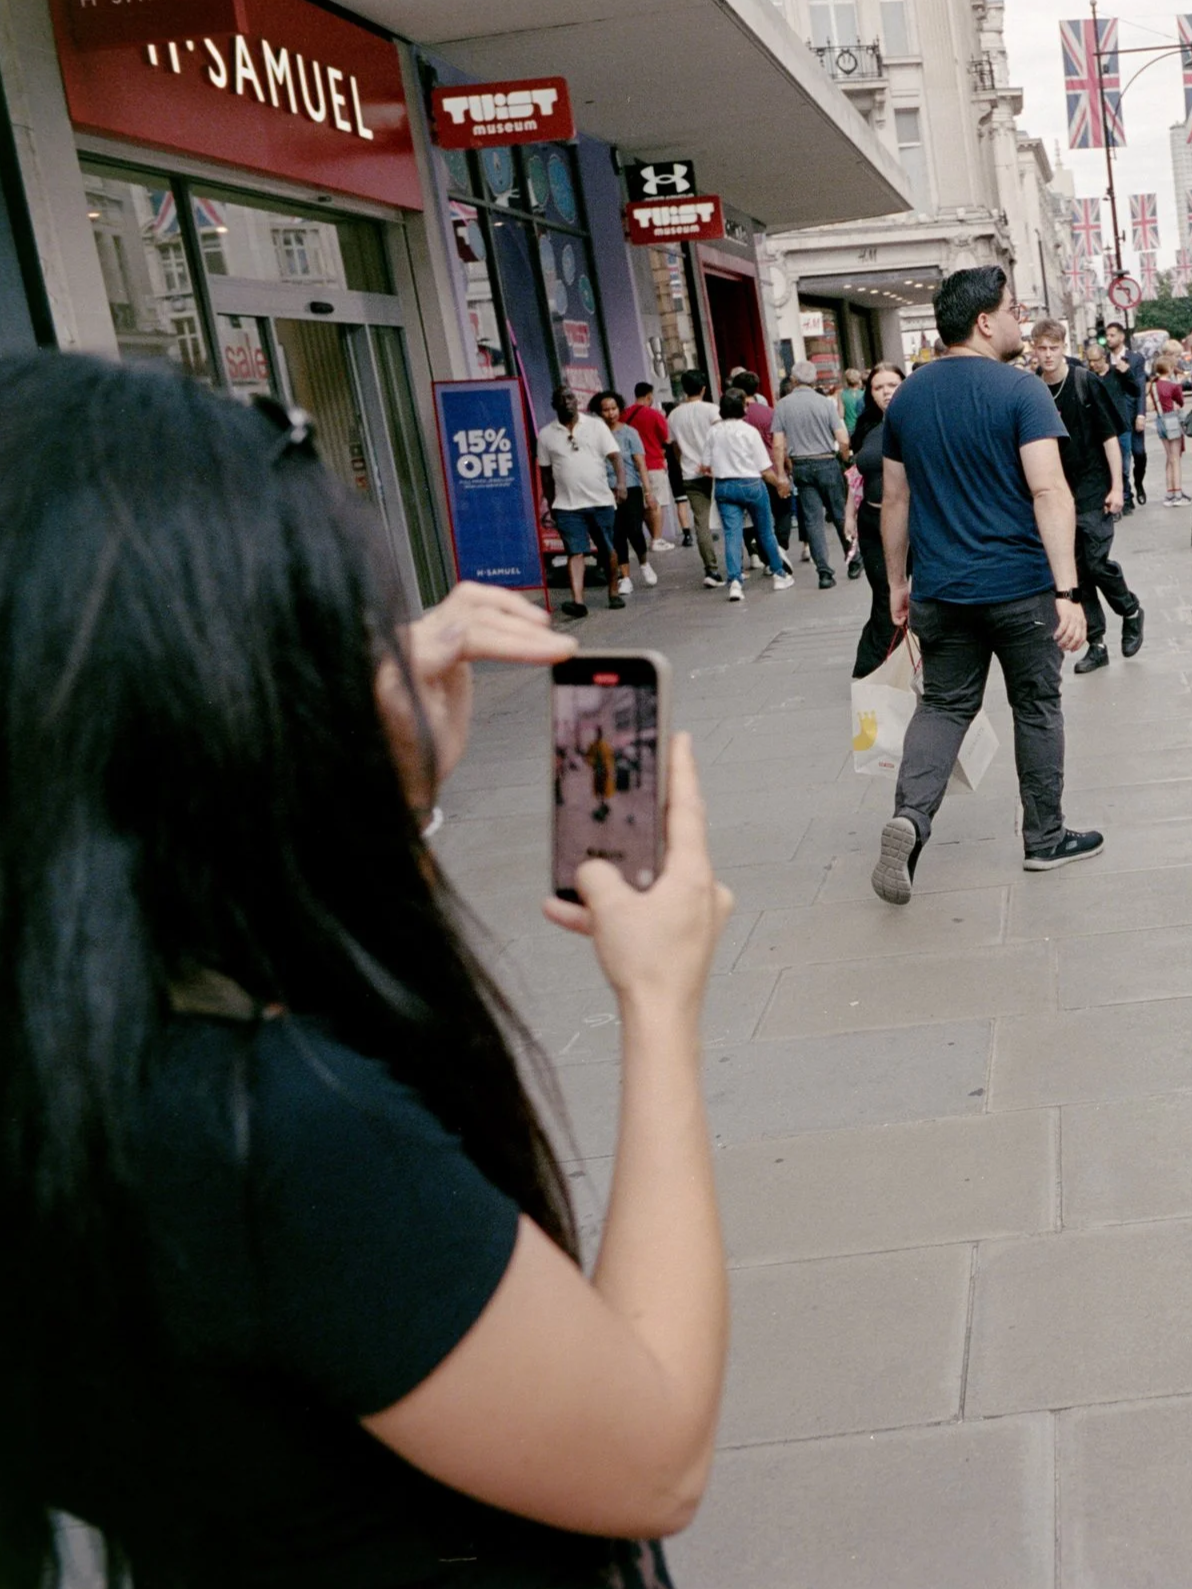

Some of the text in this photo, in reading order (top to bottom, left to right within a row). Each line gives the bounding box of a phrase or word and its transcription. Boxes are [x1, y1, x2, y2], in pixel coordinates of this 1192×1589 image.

[472, 120, 538, 136] museum
[653, 224, 700, 236] museum
[453, 428, 512, 454] 15%
[457, 453, 513, 478] OFF
